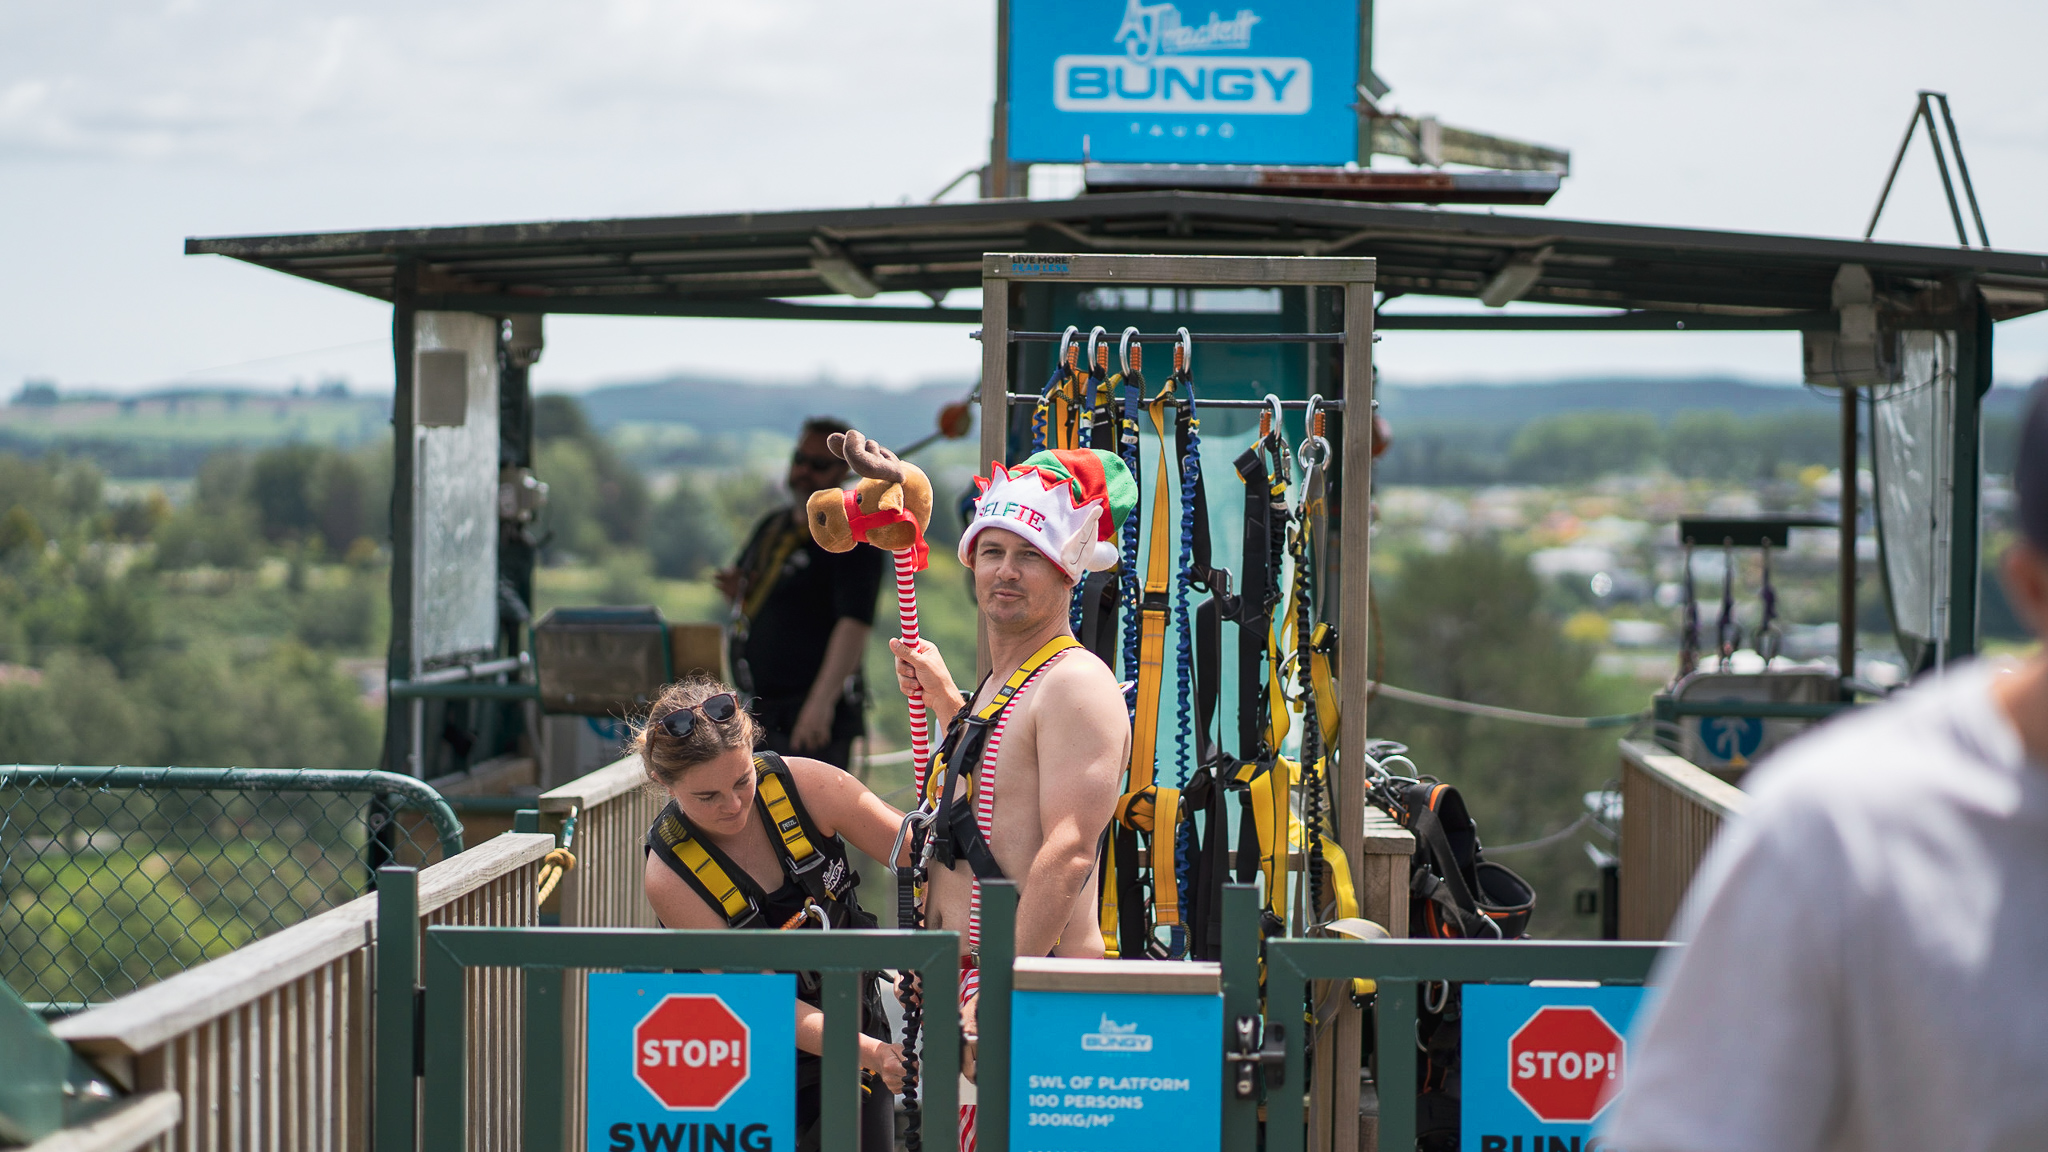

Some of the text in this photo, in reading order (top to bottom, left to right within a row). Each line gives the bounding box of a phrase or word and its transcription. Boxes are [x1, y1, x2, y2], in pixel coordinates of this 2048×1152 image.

[1068, 66, 1298, 101] BUNGY
[1012, 256, 1035, 264] LIVE
[643, 1039, 740, 1067] STOP!
[1517, 1051, 1616, 1080] STOP!
[1029, 1075, 1190, 1091] SWL OF PLATFORM
[1028, 1094, 1144, 1110] 100 PERSONS
[609, 1122, 773, 1152] SWING
